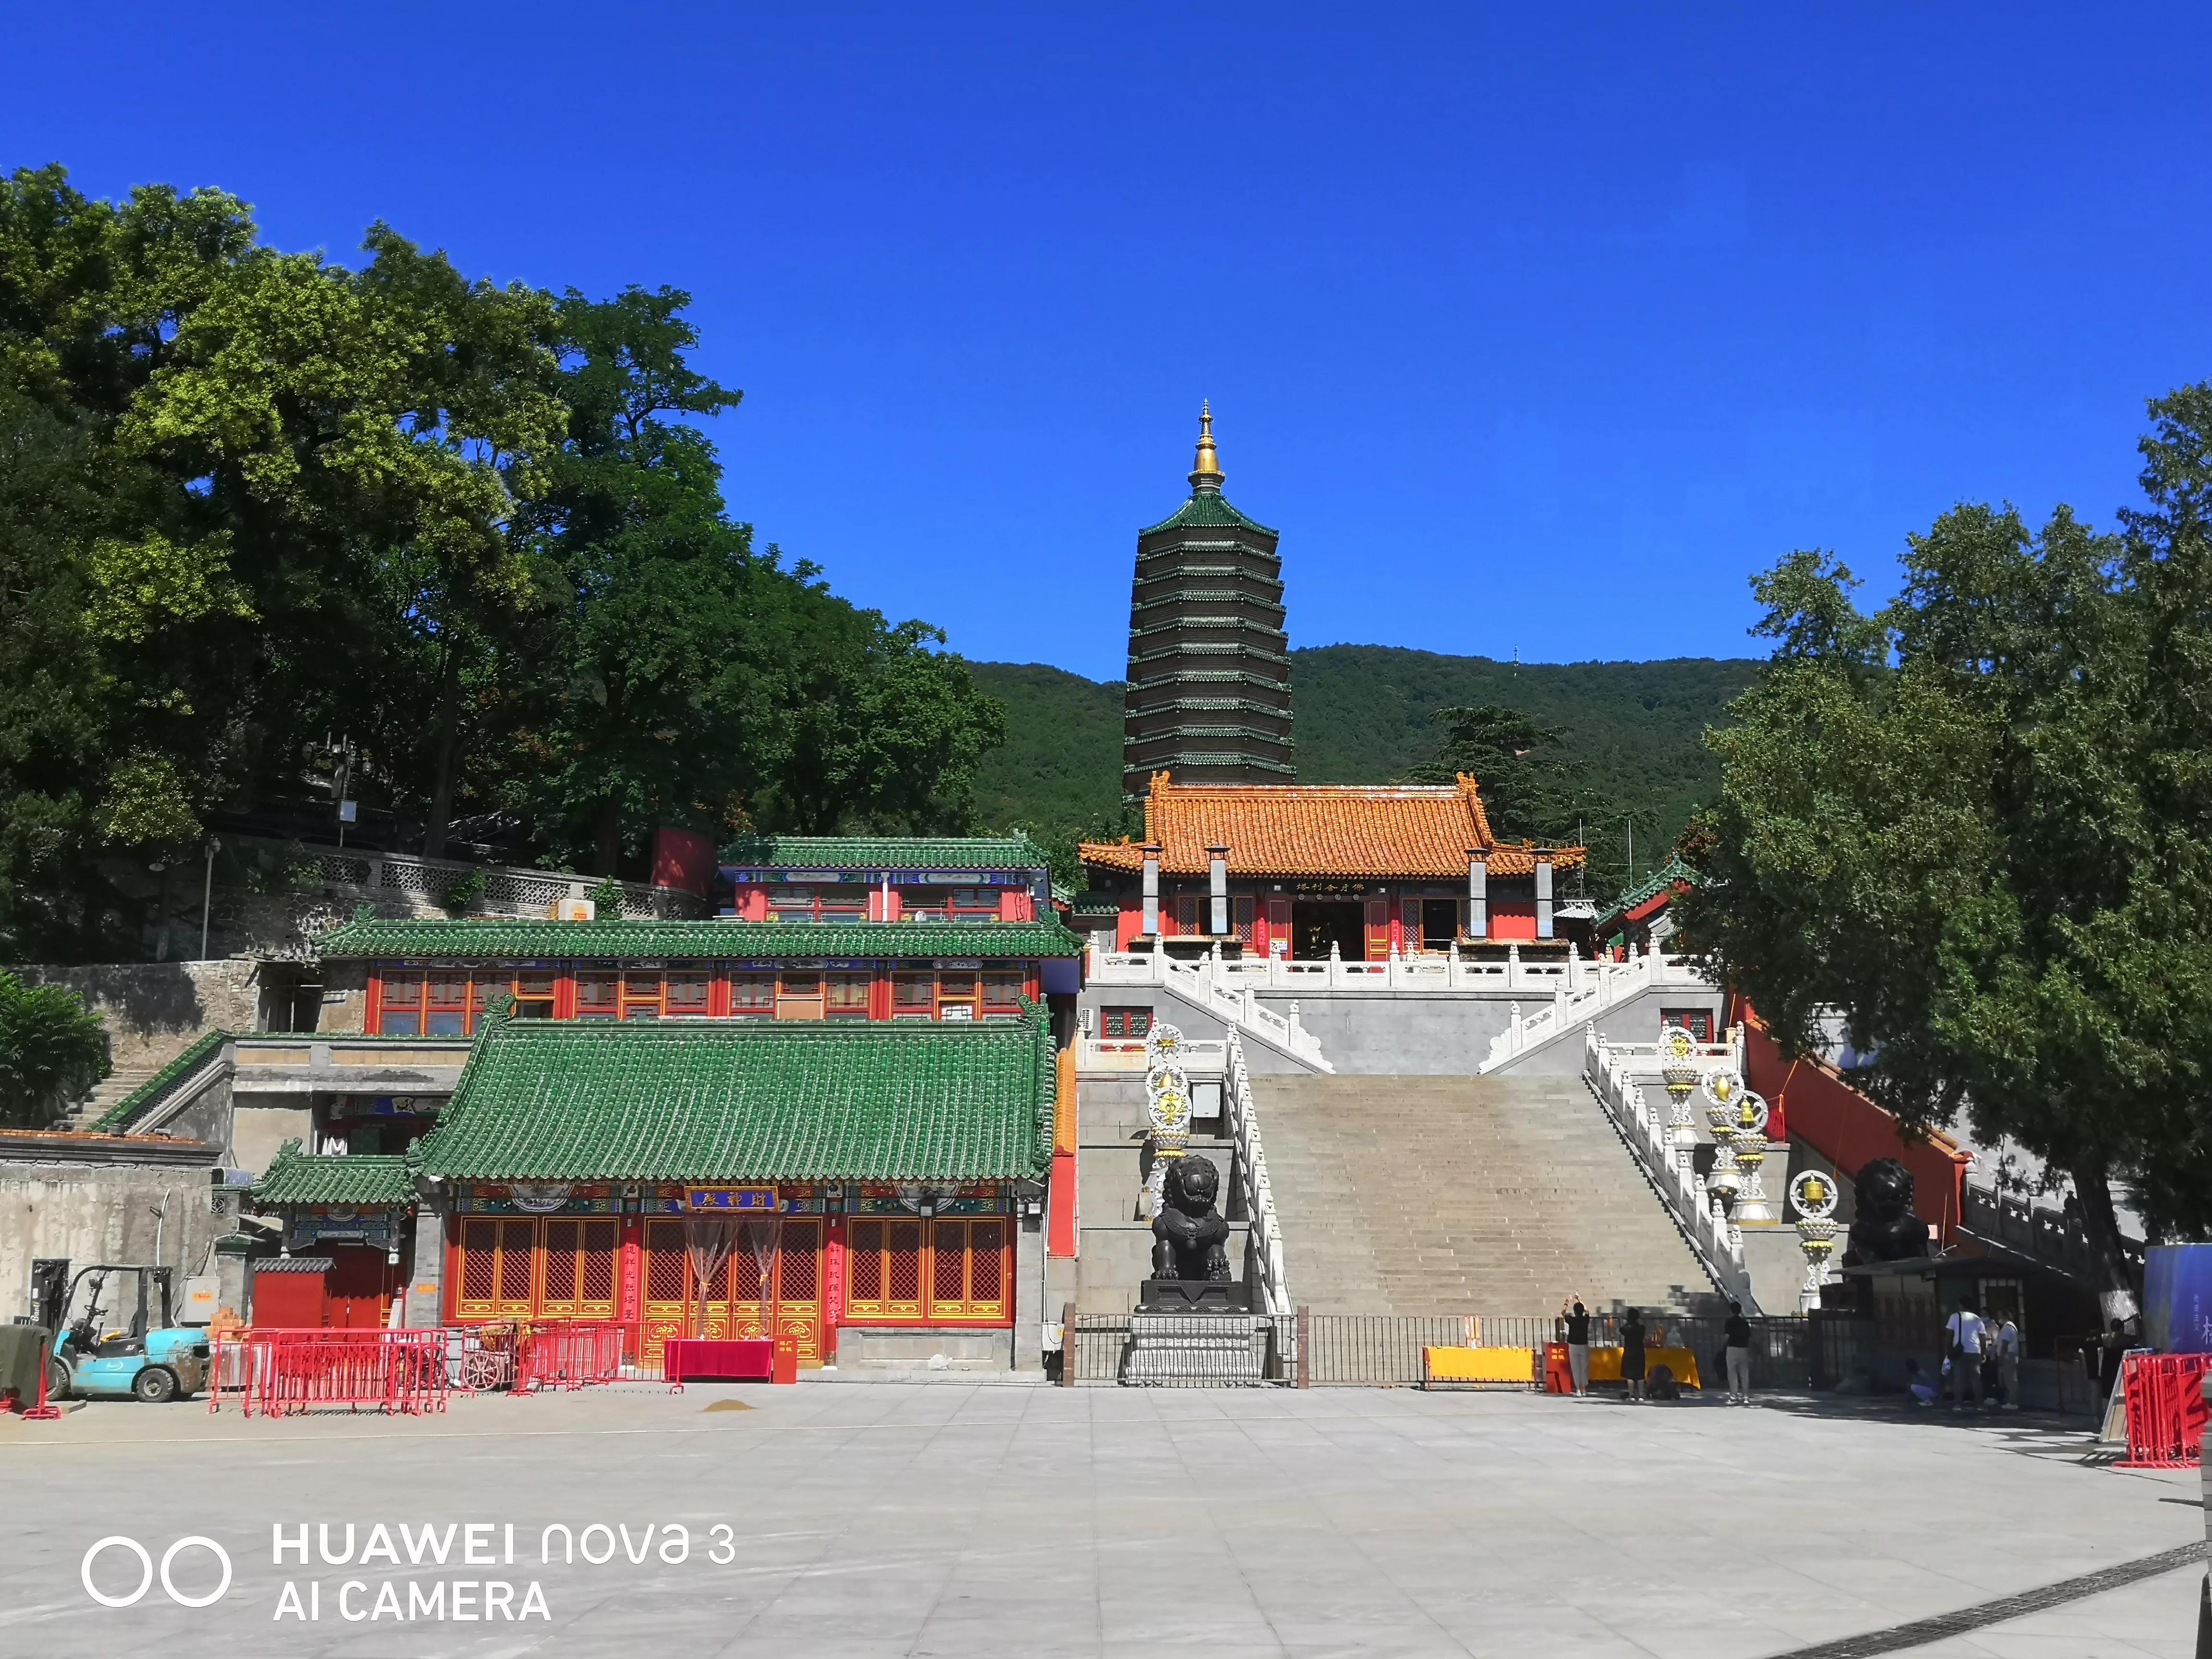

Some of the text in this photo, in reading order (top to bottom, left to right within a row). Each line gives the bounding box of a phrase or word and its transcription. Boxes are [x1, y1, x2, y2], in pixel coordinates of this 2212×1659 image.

[1296, 883, 1365, 892] 佛牙舍利塔
[701, 1191, 766, 1206] 財神殿
